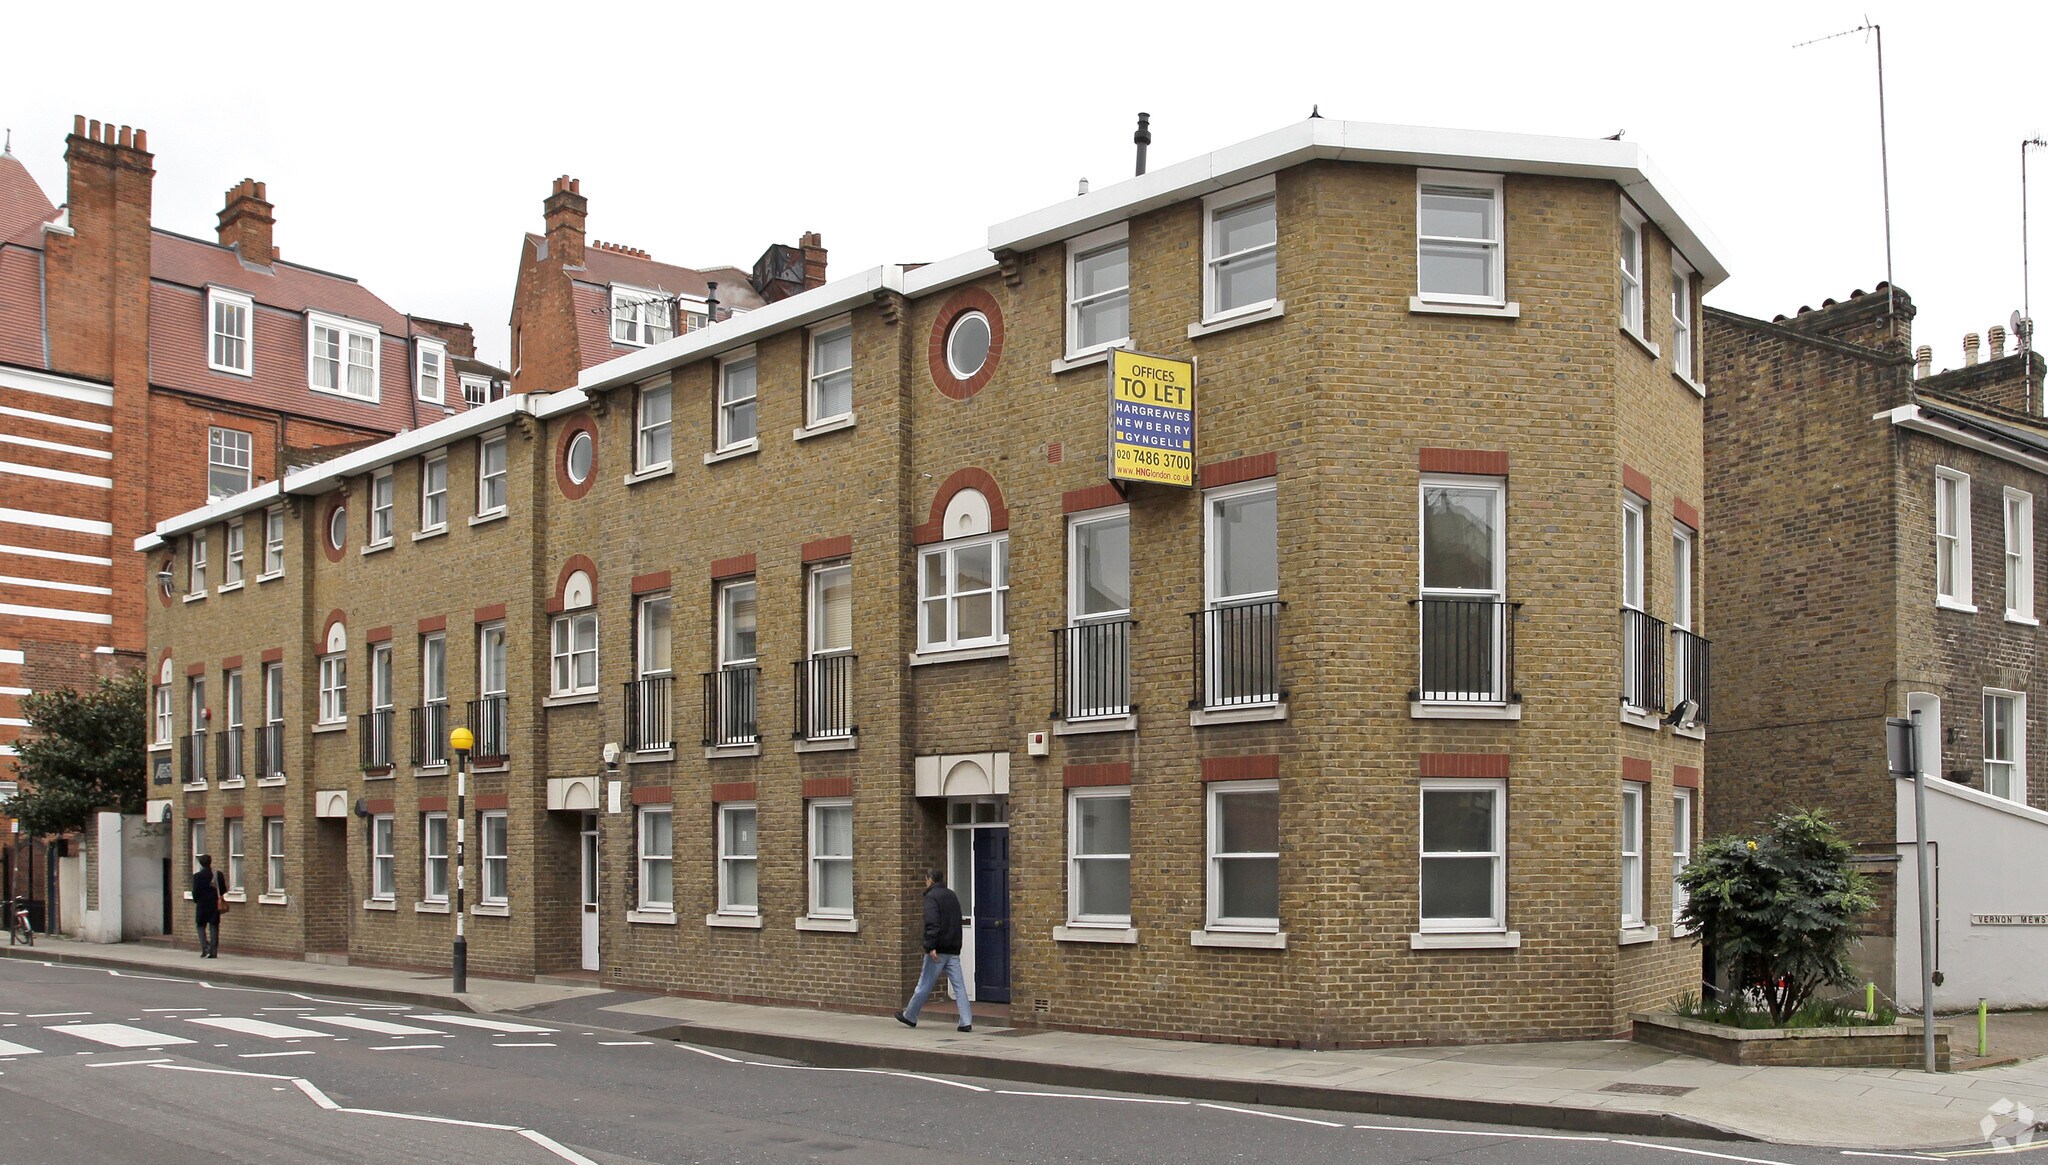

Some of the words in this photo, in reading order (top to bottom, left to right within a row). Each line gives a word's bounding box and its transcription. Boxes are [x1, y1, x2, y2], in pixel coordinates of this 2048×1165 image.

[1132, 364, 1175, 383] OFFICES
[1121, 377, 1146, 399] TO
[1154, 383, 1186, 405] LET
[1116, 403, 1190, 422] HARGREAVES
[1116, 417, 1190, 436] NEWBERRY
[1125, 432, 1181, 448] GYNGELL
[1116, 449, 1131, 460] 020
[1133, 449, 1160, 466] 7486
[1163, 453, 1191, 470] 3700
[1116, 466, 1190, 482] www.HNGlondon.co.uk
[1978, 915, 2013, 924] VERNON
[2020, 915, 2046, 924] MEWS
